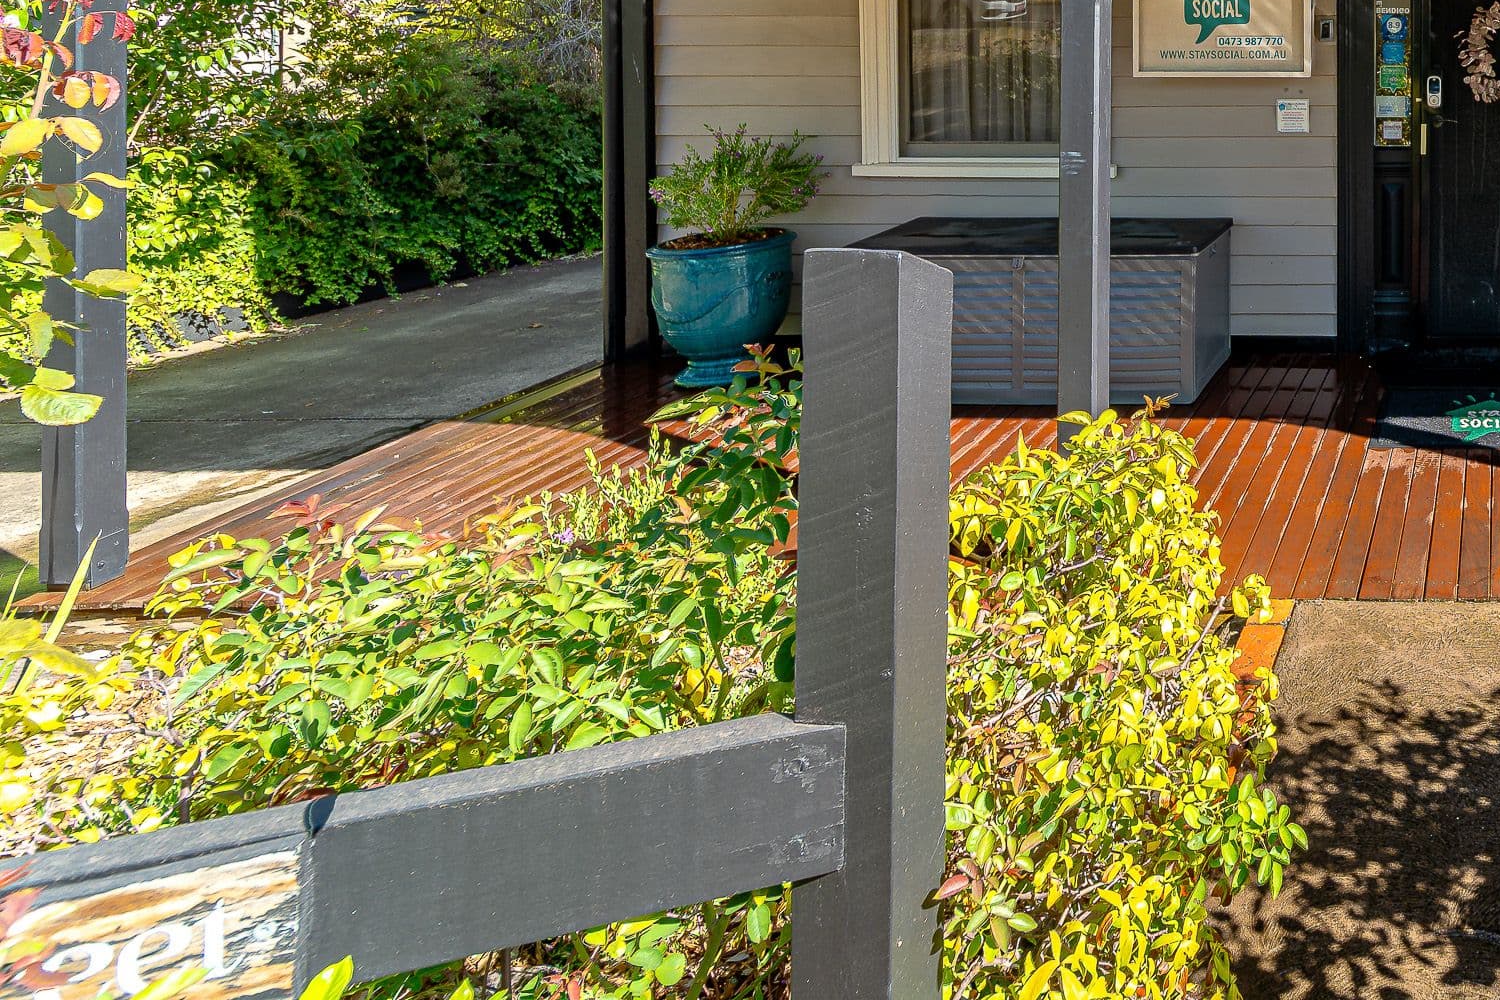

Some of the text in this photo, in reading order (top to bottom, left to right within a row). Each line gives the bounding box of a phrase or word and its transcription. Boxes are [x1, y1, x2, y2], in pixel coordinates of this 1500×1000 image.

[1192, 0, 1242, 18] SOCIAL
[1219, 37, 1283, 46] 0473 987 770
[1160, 50, 1286, 59] WWW.STAYSOCIAL.COM.AU
